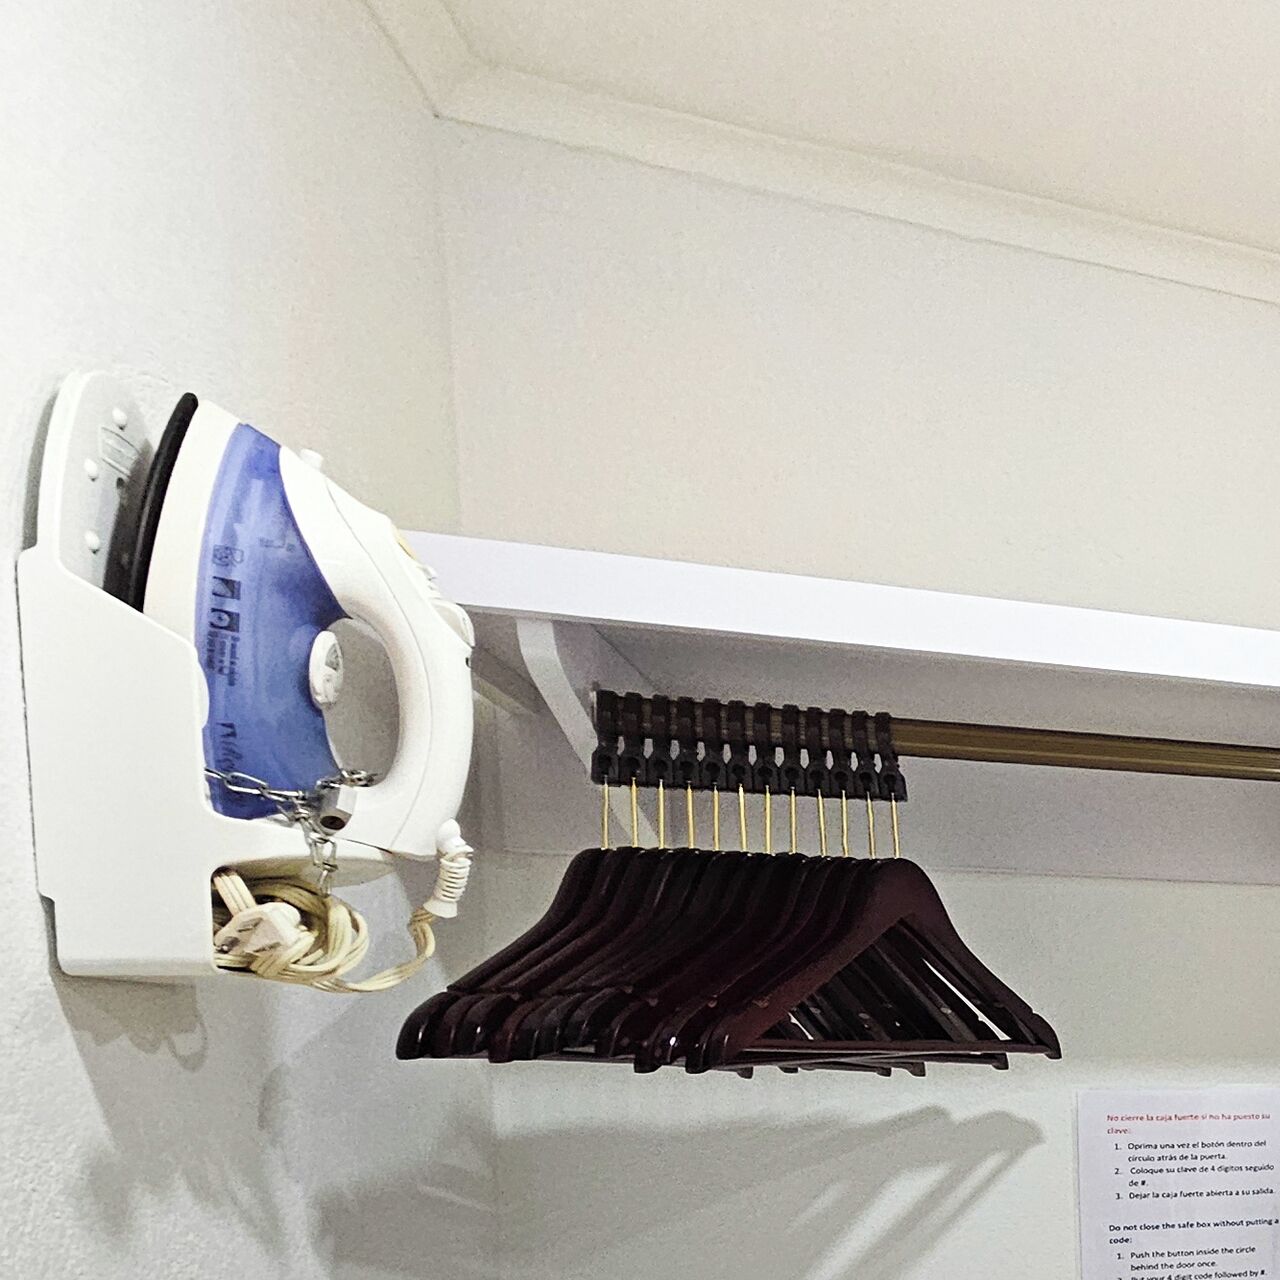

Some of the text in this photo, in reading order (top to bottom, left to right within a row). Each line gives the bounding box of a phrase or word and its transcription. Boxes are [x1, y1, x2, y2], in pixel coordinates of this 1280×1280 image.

[1107, 1114, 1119, 1122] No
[1121, 1114, 1144, 1122] cierre
[1156, 1114, 1172, 1122] caja
[1233, 1113, 1260, 1121] puesto
[1128, 1142, 1158, 1151] Oprima
[1130, 1167, 1164, 1176] Coloque
[1245, 1164, 1274, 1172] seguido
[1129, 1192, 1150, 1200] Dejar
[1140, 1223, 1160, 1231] close
[1162, 1222, 1175, 1230] the
[1213, 1220, 1245, 1228] without
[1246, 1218, 1273, 1227] putting
[1168, 1249, 1195, 1258] button
[1196, 1248, 1219, 1256] inside
[1131, 1263, 1159, 1272] behind
[1176, 1261, 1195, 1269] door
[1194, 1272, 1213, 1280] code
[1214, 1270, 1247, 1279] followed
[1249, 1270, 1259, 1278] by
